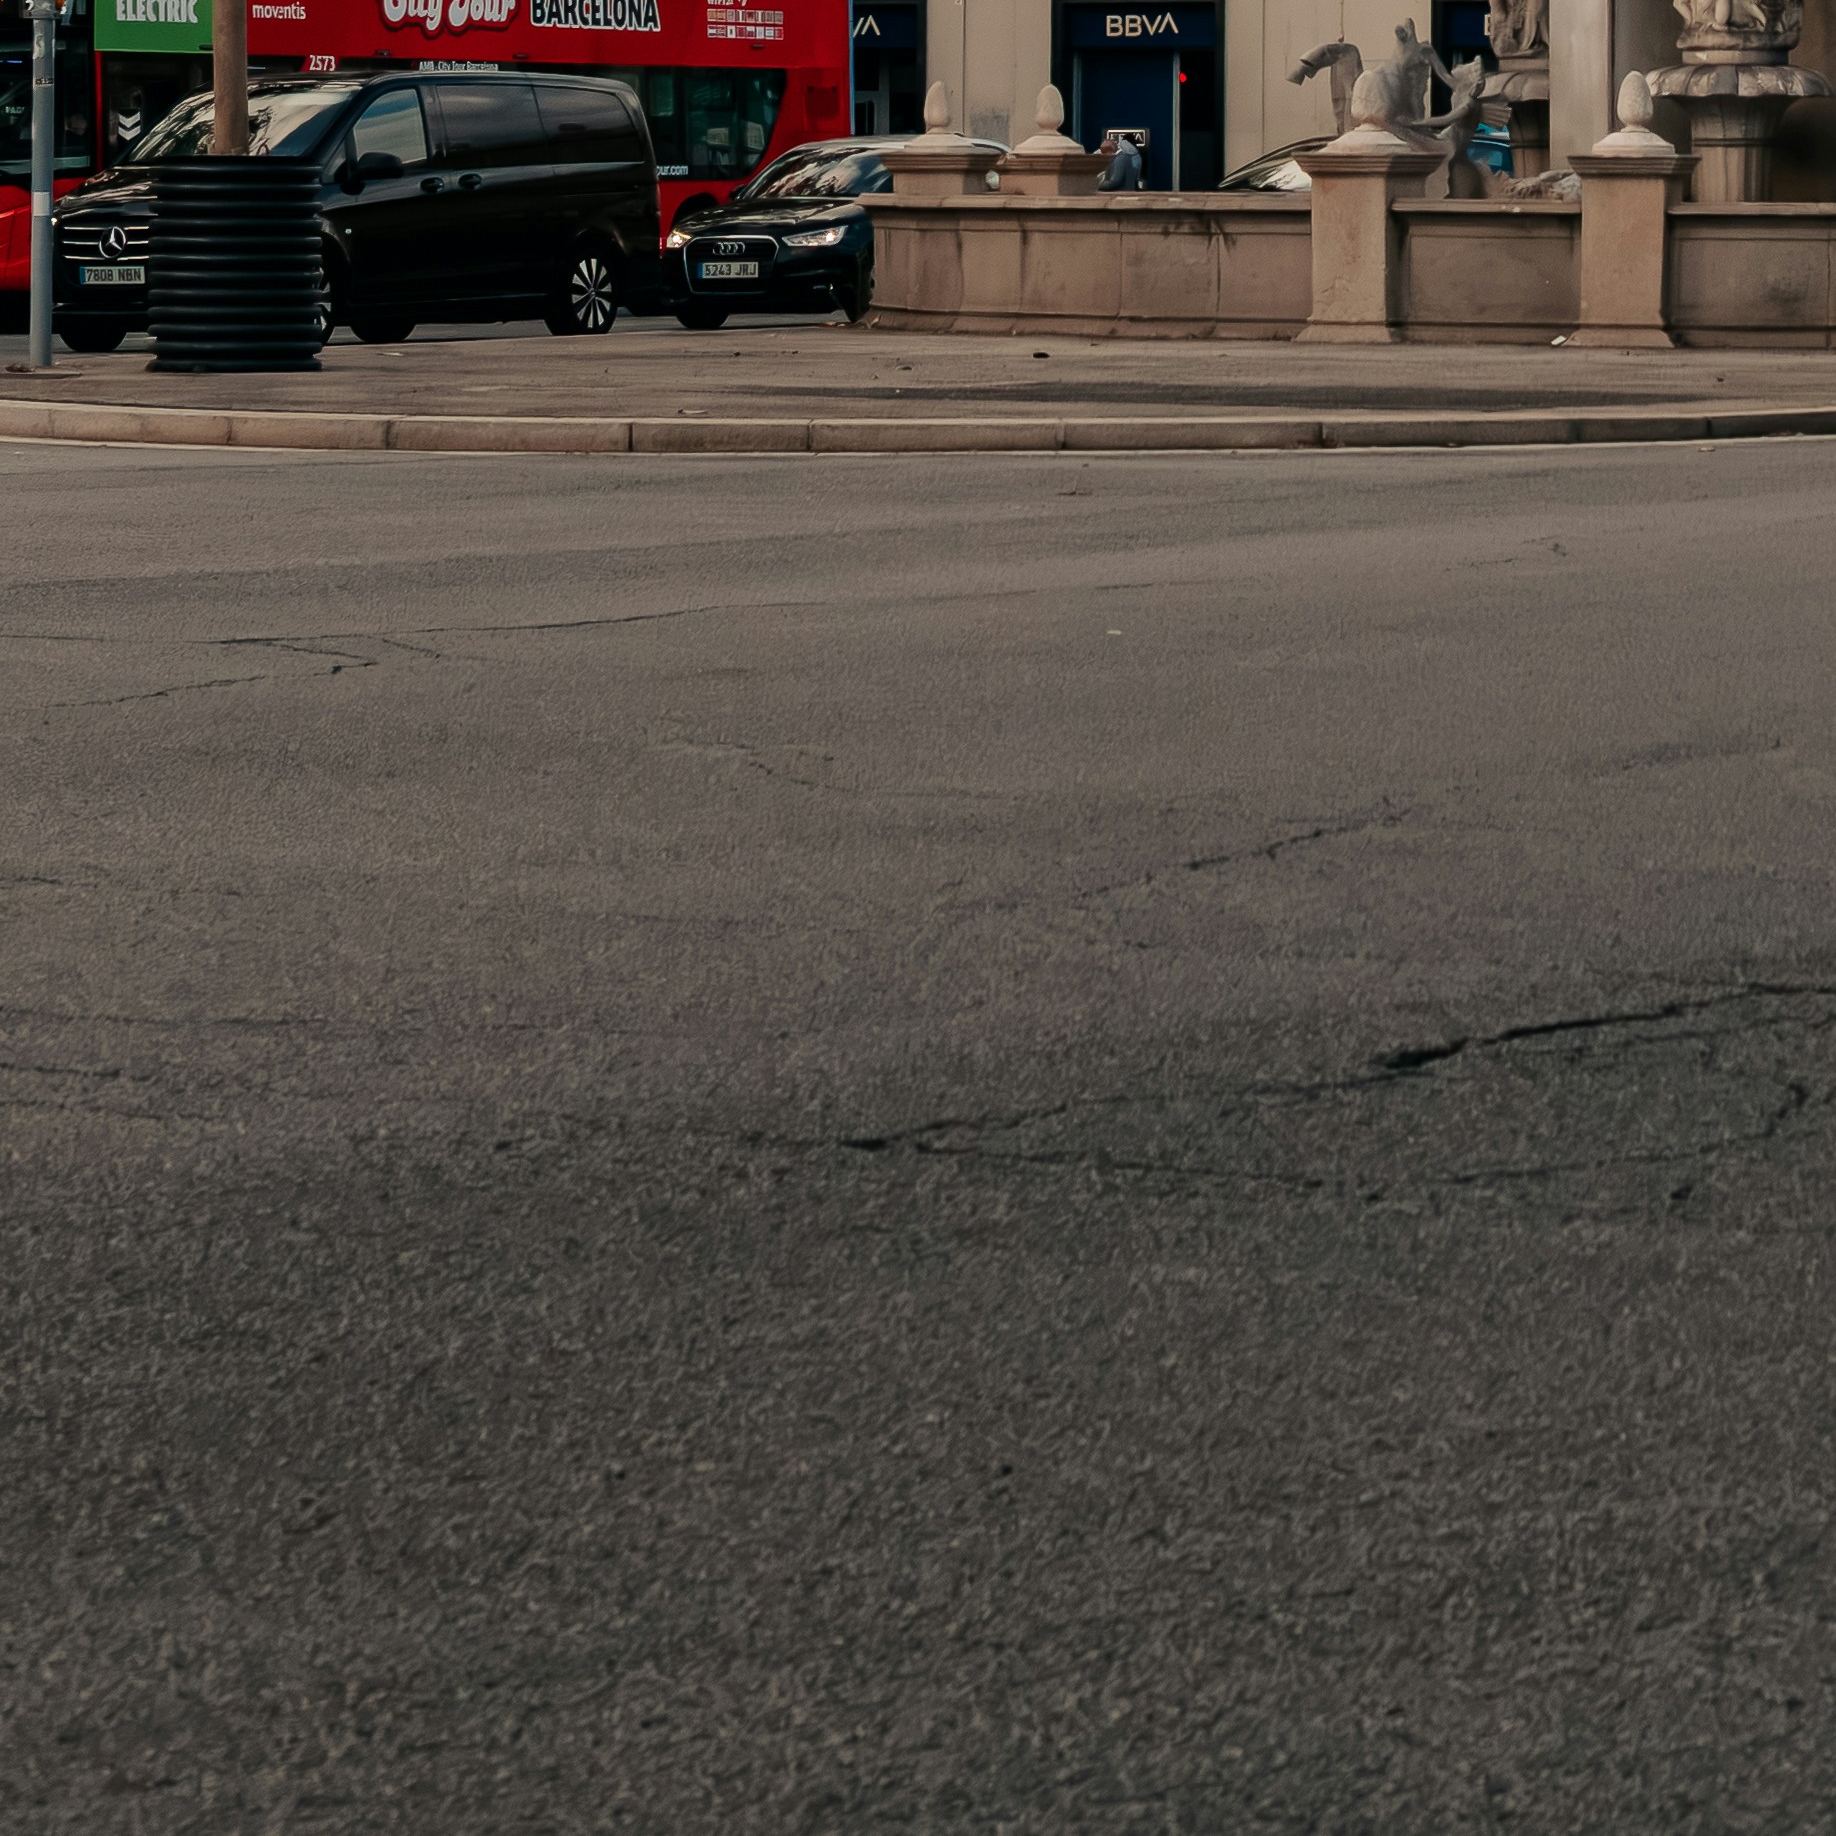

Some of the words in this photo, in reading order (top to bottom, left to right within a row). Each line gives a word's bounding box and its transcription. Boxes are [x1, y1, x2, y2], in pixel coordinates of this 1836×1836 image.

[252, 1, 306, 20] moventis
[1106, 11, 1179, 37] BBVA
[310, 55, 336, 72] 2573
